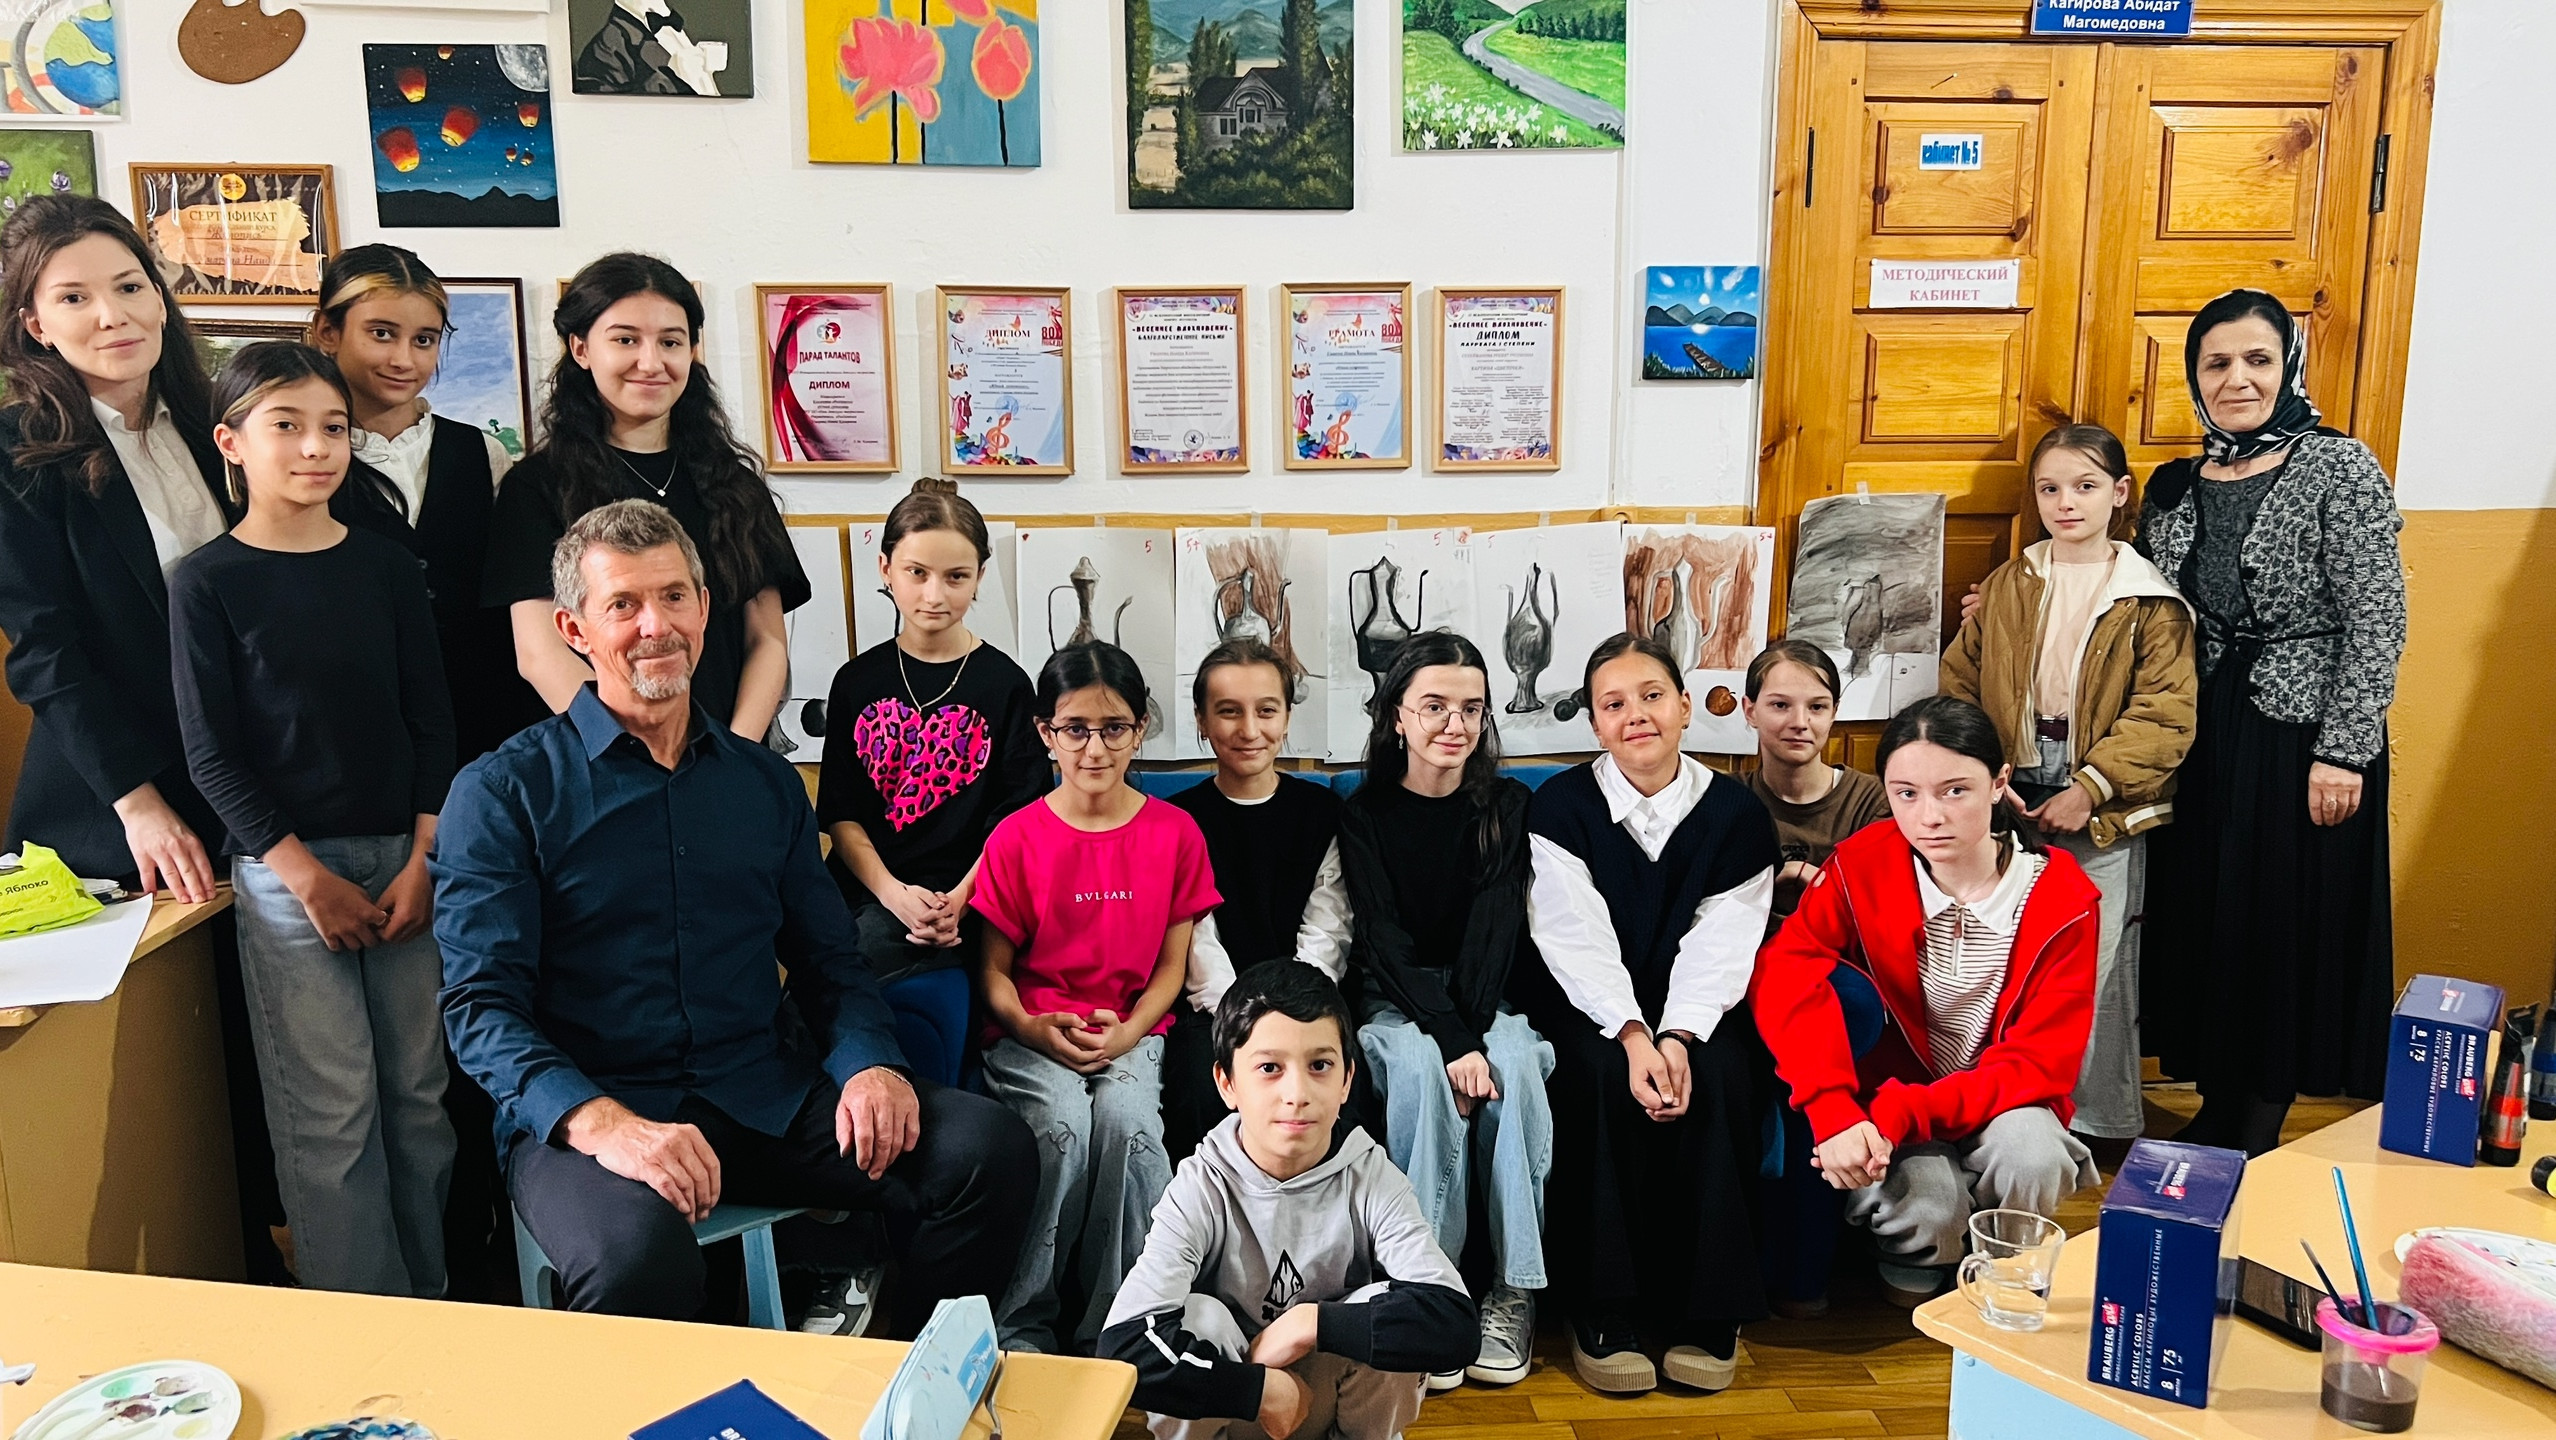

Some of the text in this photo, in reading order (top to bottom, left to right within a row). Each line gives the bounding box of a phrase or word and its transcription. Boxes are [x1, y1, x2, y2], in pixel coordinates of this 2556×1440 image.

[2123, 0, 2180, 12] Абидат
[2063, 15, 2165, 31] Магомедовна
[1922, 141, 1960, 164] кабинет
[1972, 141, 1978, 164] 5
[1882, 267, 2008, 281] МЕТОДИЧЕСКИЙ
[1910, 290, 1980, 301] КАБИНЕТ
[985, 329, 1030, 340] ДИПЛОМ
[1042, 327, 1055, 339] 80
[1477, 331, 1520, 340] ДИПЛОМ
[800, 351, 860, 364] ПАРАД ТАЛАНТОВ
[809, 381, 850, 390] ДИПЛОМ
[864, 529, 872, 545] 5
[1434, 531, 1442, 546] 5
[1145, 540, 1152, 553] 5
[5, 880, 49, 895] Яблоко
[1075, 891, 1133, 903] BVLGARI
[2414, 1049, 2426, 1061] 75
[2146, 1307, 2158, 1355] АКРИЛОВЫЕ
[2102, 1303, 2118, 1380] BRAUBERG art
[2131, 1313, 2144, 1387] ACRYLIC COLORS
[2143, 1358, 2152, 1389] КРАСКИ
[2161, 1349, 2177, 1390] 8 75
